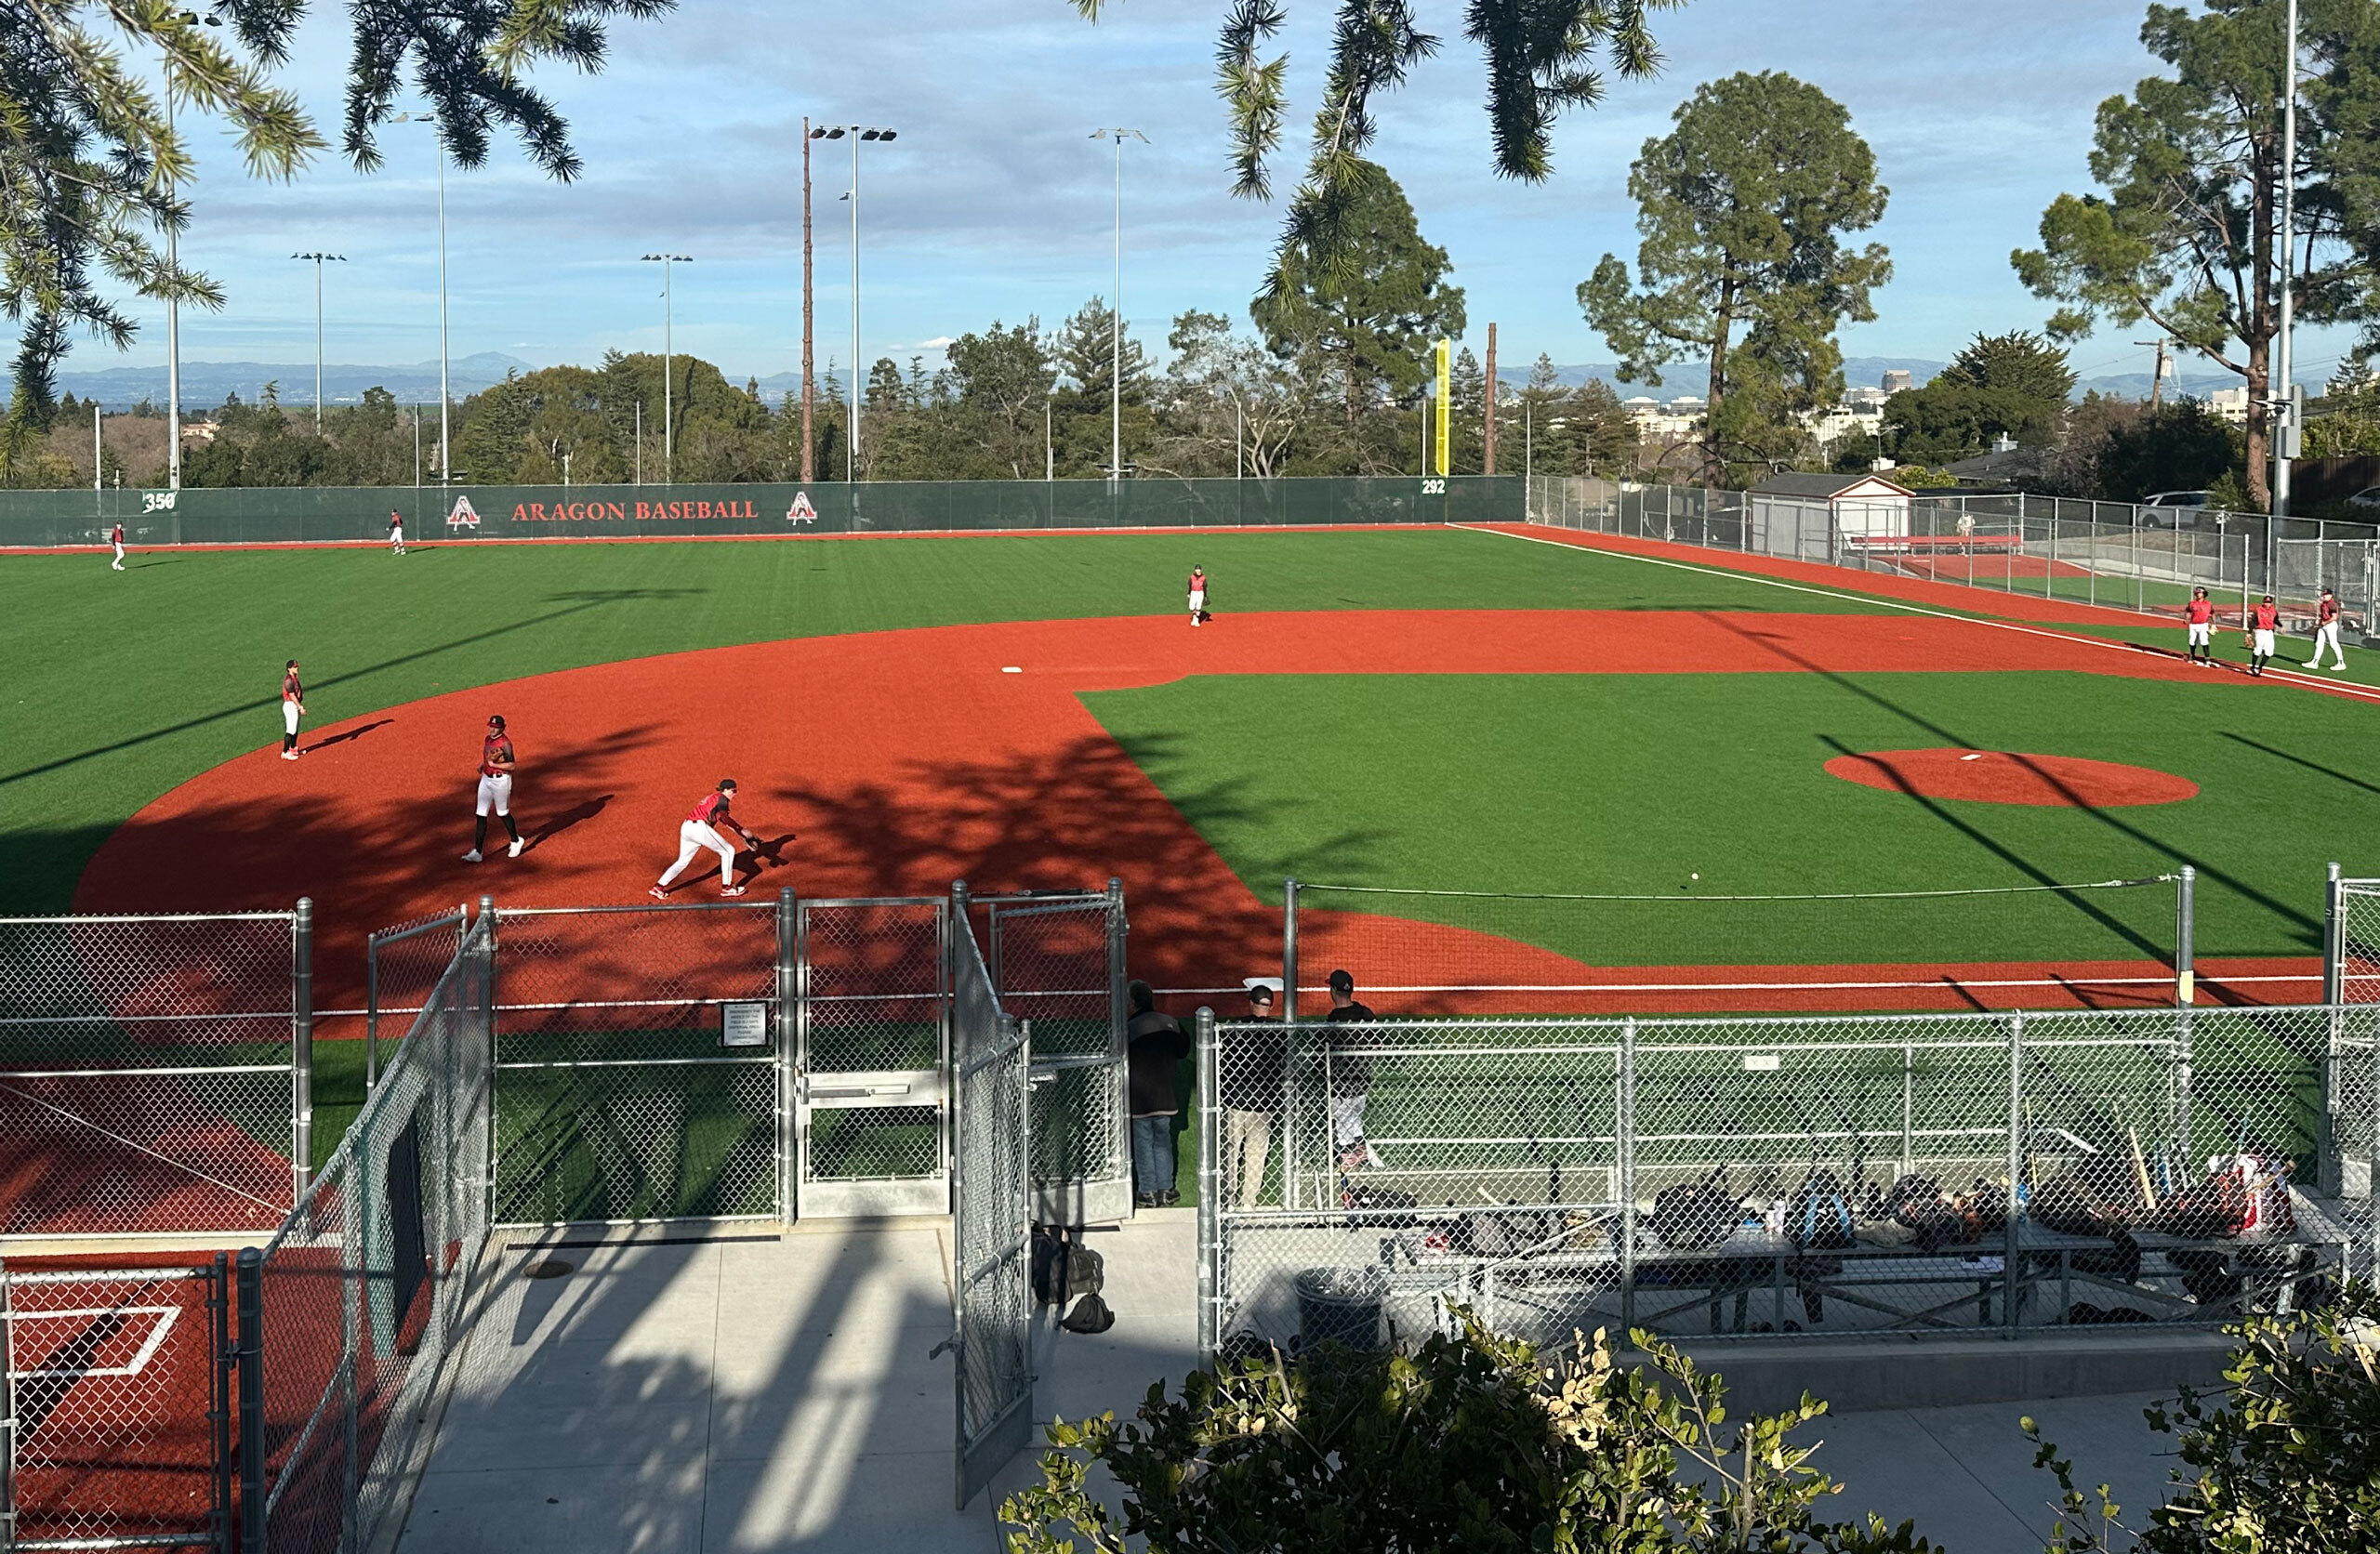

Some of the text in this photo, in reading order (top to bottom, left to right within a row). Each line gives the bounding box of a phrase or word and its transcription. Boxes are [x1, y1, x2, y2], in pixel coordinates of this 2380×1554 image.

[1421, 479, 1446, 494] 292
[145, 493, 176, 510] 350
[511, 500, 760, 521] ARAGON BASEBALL
